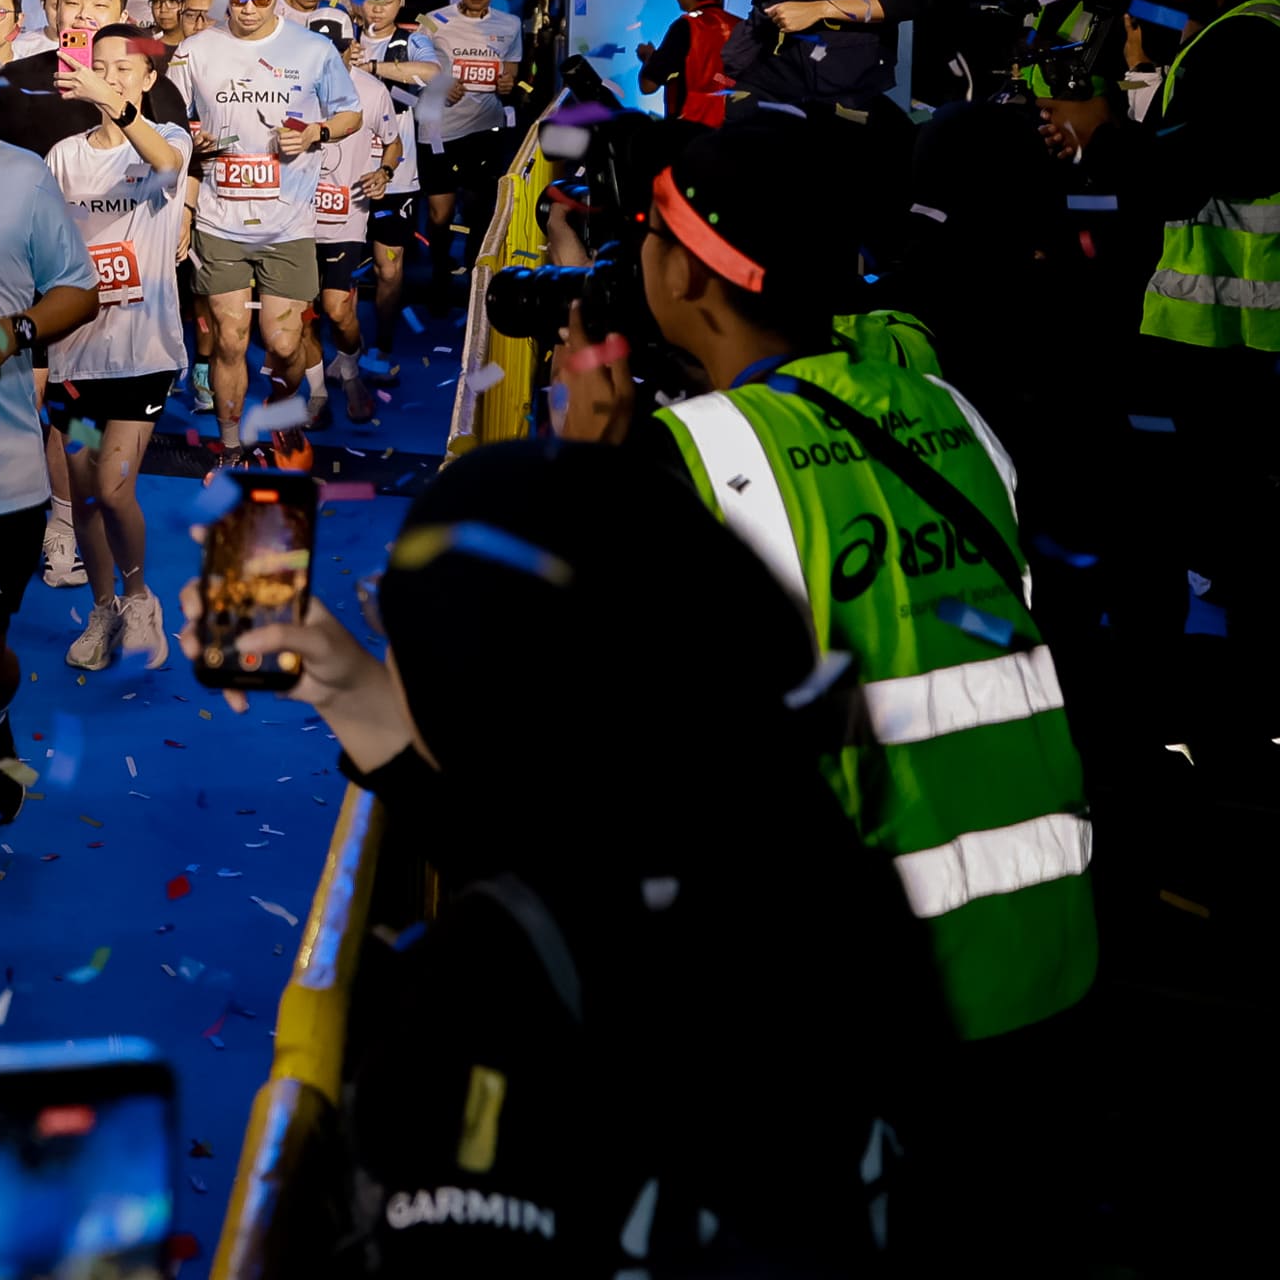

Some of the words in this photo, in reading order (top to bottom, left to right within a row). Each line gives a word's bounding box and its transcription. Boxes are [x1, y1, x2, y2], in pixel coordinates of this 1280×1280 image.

[452, 47, 500, 57] GARMIN
[463, 66, 496, 82] 1599
[215, 91, 290, 104] GARMIN
[228, 164, 274, 184] 2001
[386, 1185, 556, 1240] GARMIN
